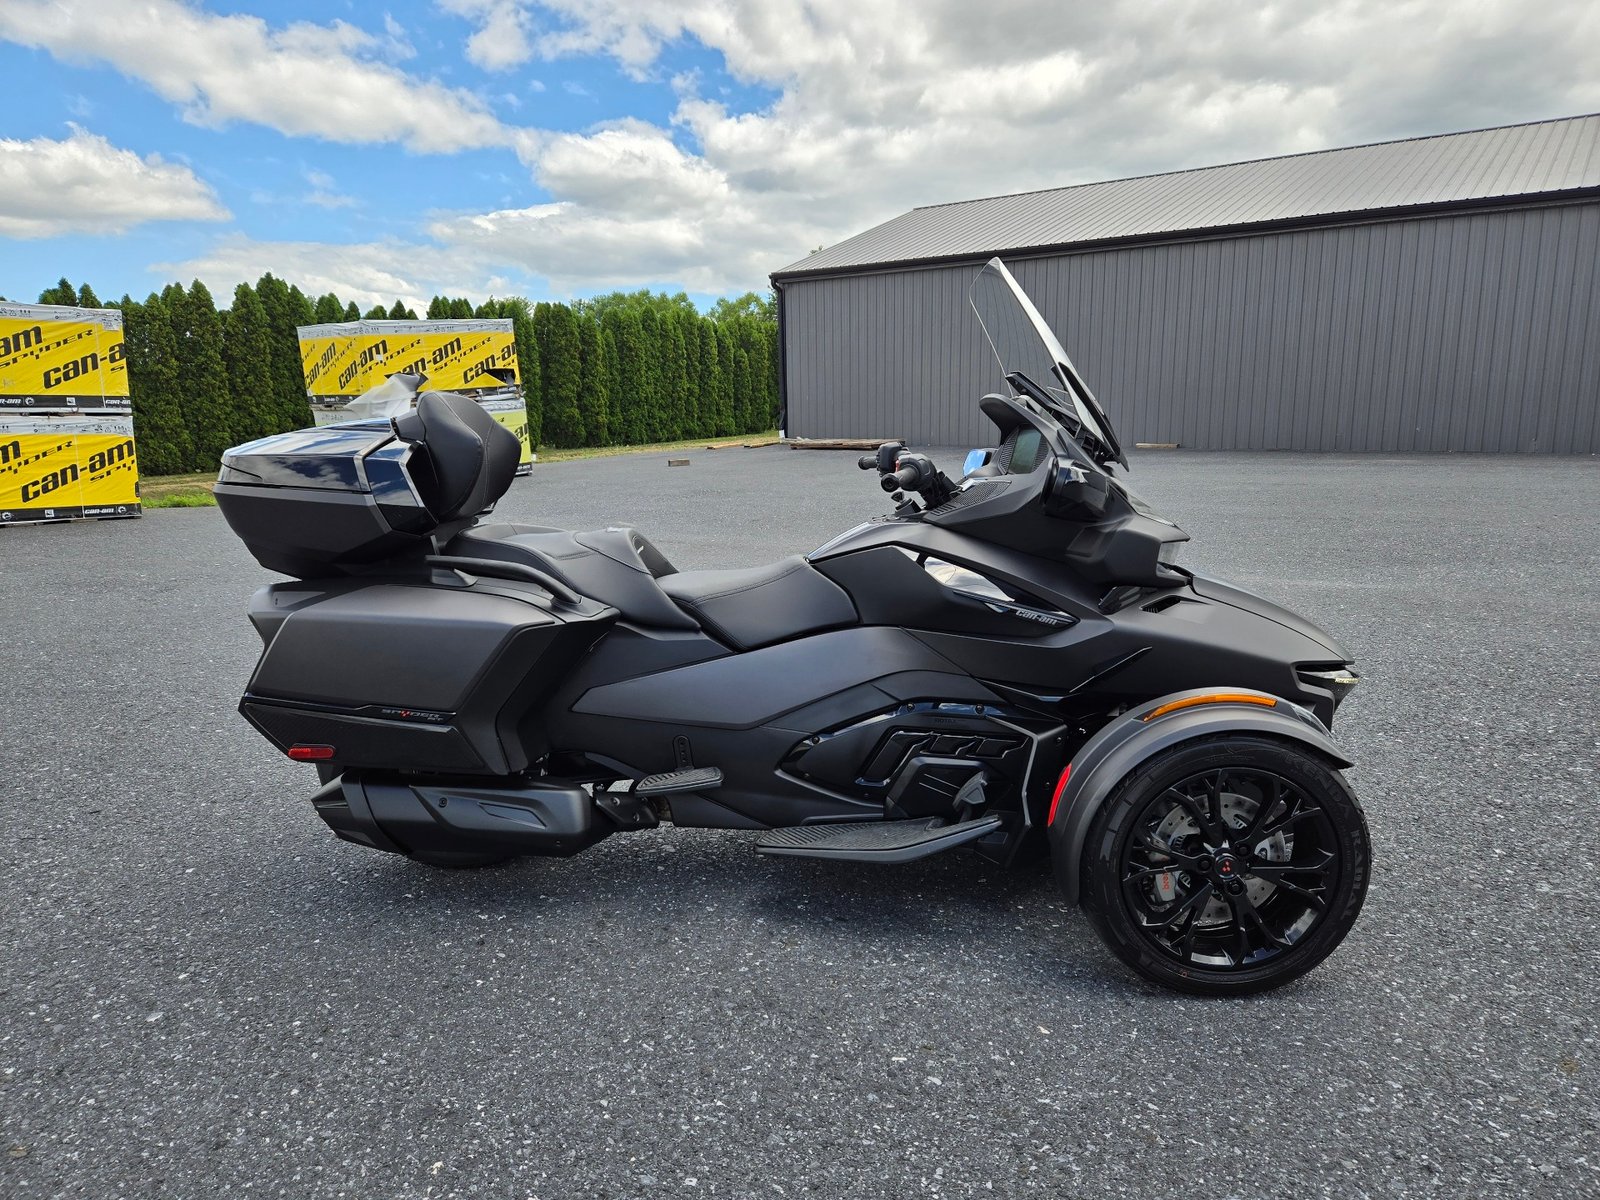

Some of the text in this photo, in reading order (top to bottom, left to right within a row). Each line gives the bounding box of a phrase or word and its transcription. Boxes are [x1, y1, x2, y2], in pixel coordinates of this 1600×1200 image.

[338, 340, 387, 390] can-am
[21, 440, 134, 503] can-am
[1016, 608, 1058, 626] can-am
[382, 709, 440, 718] SPYDER
